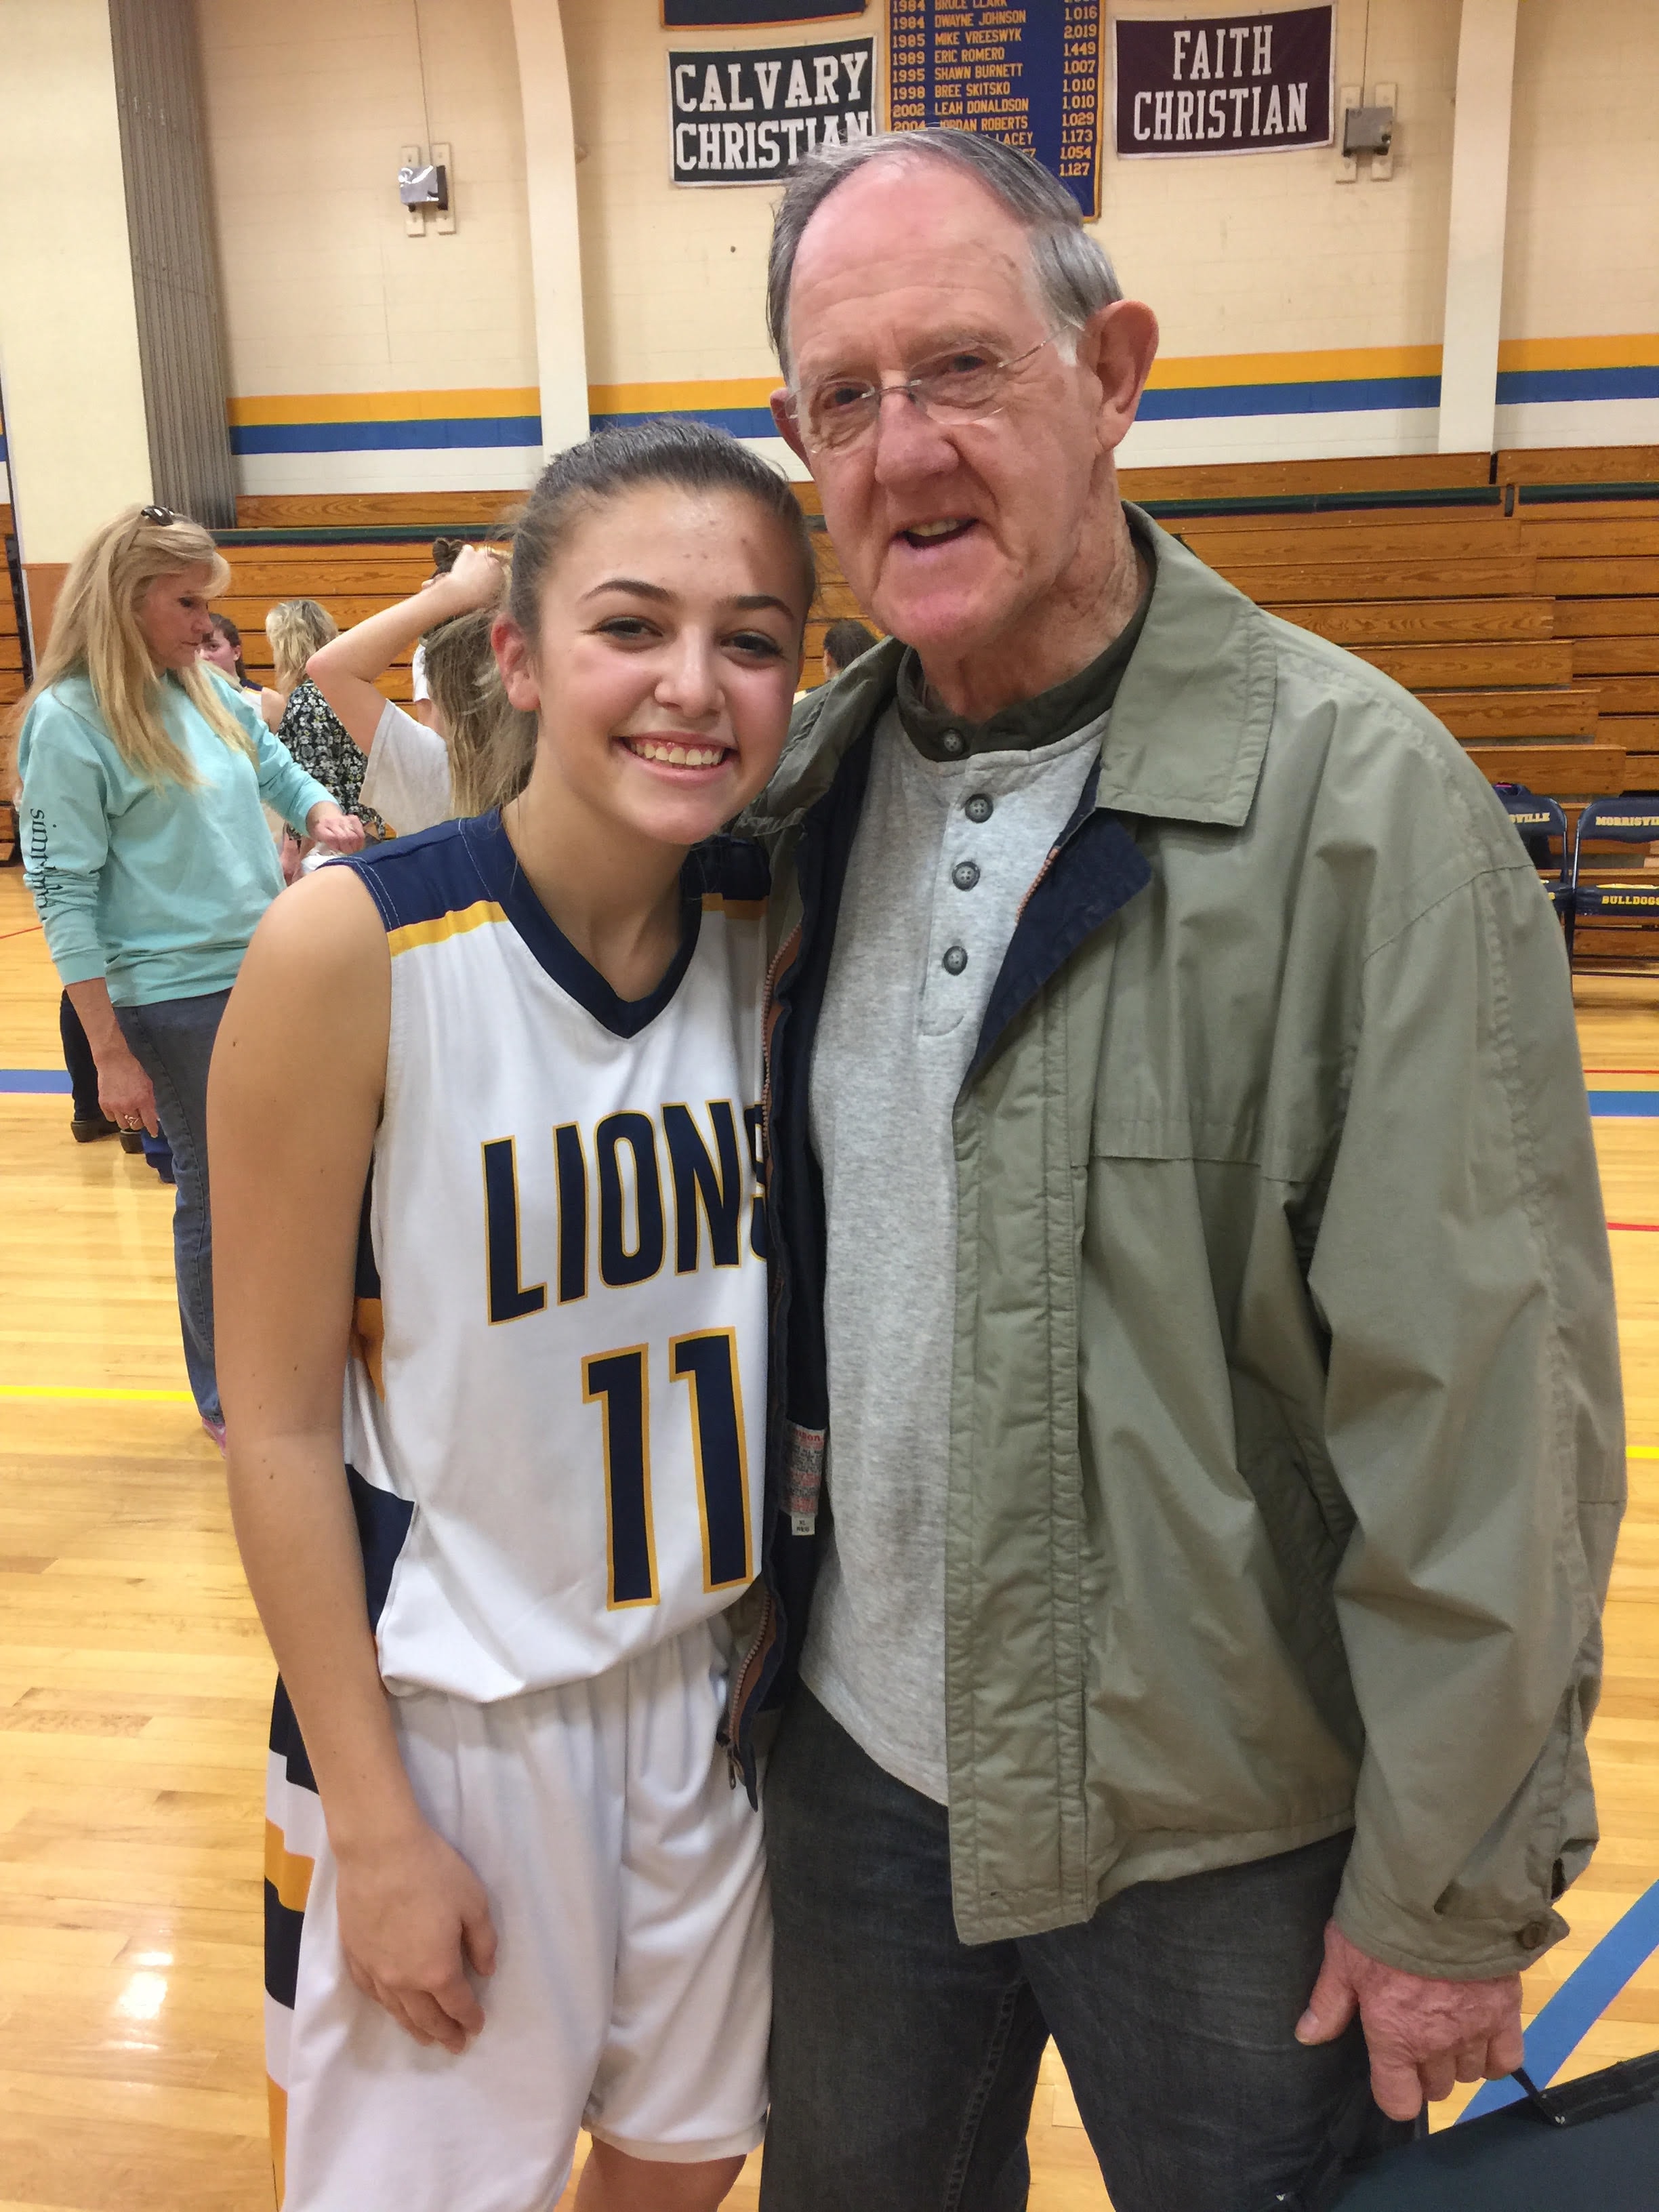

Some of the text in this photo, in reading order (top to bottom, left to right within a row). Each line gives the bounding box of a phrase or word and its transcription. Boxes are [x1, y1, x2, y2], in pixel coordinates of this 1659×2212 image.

[893, 0, 926, 13] 1984
[935, 0, 968, 11] BRUCE
[893, 16, 926, 30] 1984
[935, 13, 974, 28] DWAYNE
[979, 9, 1027, 26] JOHNSON
[893, 33, 926, 48] 1985
[935, 31, 960, 45] MIKE
[965, 28, 1022, 44] VREESWYK
[893, 51, 926, 66] 1989
[935, 49, 958, 64] ERIC
[961, 47, 1005, 62] ROMERO
[1172, 24, 1273, 81] FAITH
[675, 51, 868, 112] CALVARY
[893, 68, 926, 83] 1995
[935, 66, 971, 81] SHAWN
[975, 63, 1023, 79] BURNETT
[893, 85, 926, 100] 1998
[935, 84, 962, 98] BREE
[966, 81, 1010, 97] SKITSKO
[893, 103, 926, 118] 2002
[934, 101, 963, 116] LEAH
[966, 98, 1029, 114] DONALDSON
[1133, 82, 1308, 141] CHRISTIAN
[893, 120, 926, 131] 2004
[981, 115, 1029, 131] ROBERTS
[676, 110, 869, 170] CHRISTIAN
[581, 1326, 754, 1612] 11
